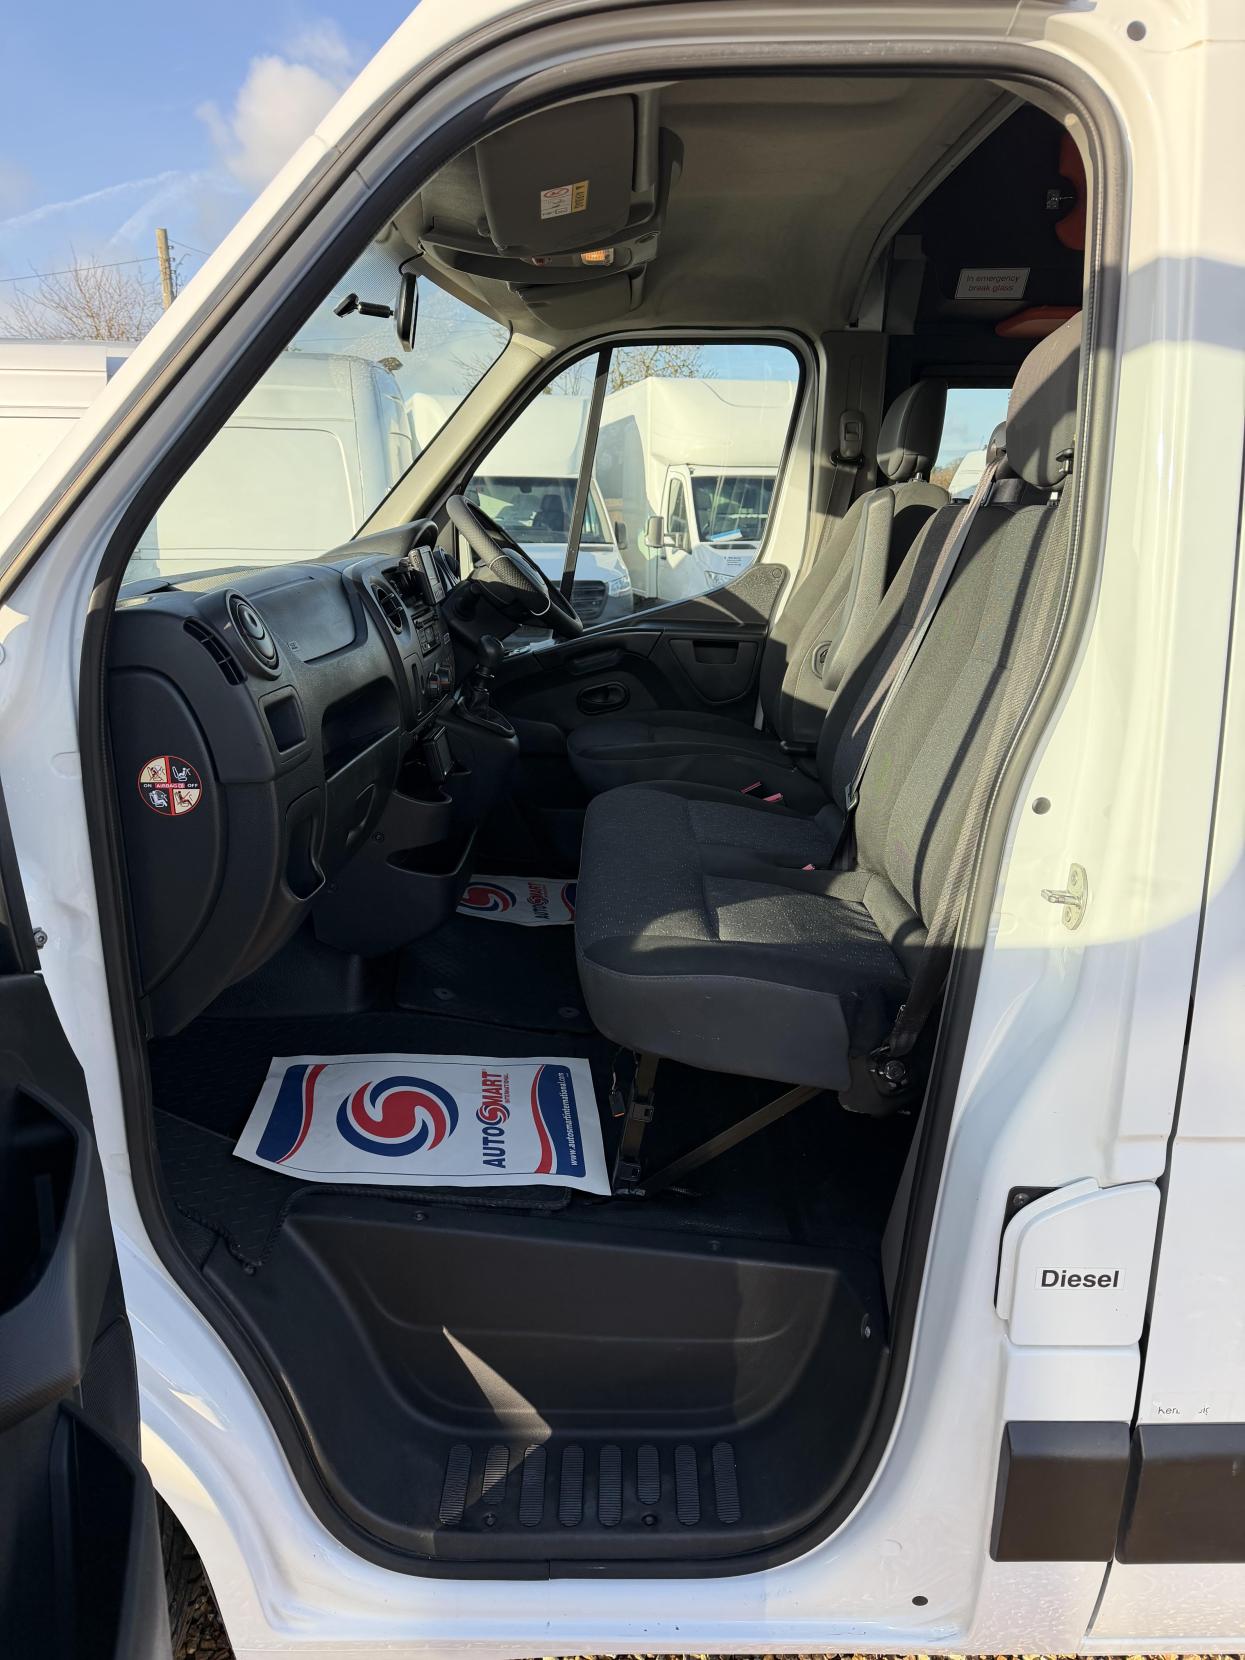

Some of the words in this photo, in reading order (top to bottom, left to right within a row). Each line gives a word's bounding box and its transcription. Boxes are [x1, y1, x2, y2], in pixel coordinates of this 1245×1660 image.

[966, 274, 974, 282] In
[976, 274, 1020, 283] emergency
[968, 284, 990, 292] break
[991, 284, 1015, 293] glass
[558, 1072, 579, 1166] www.autosmartinternational.com
[1041, 1269, 1120, 1288] Diesel
